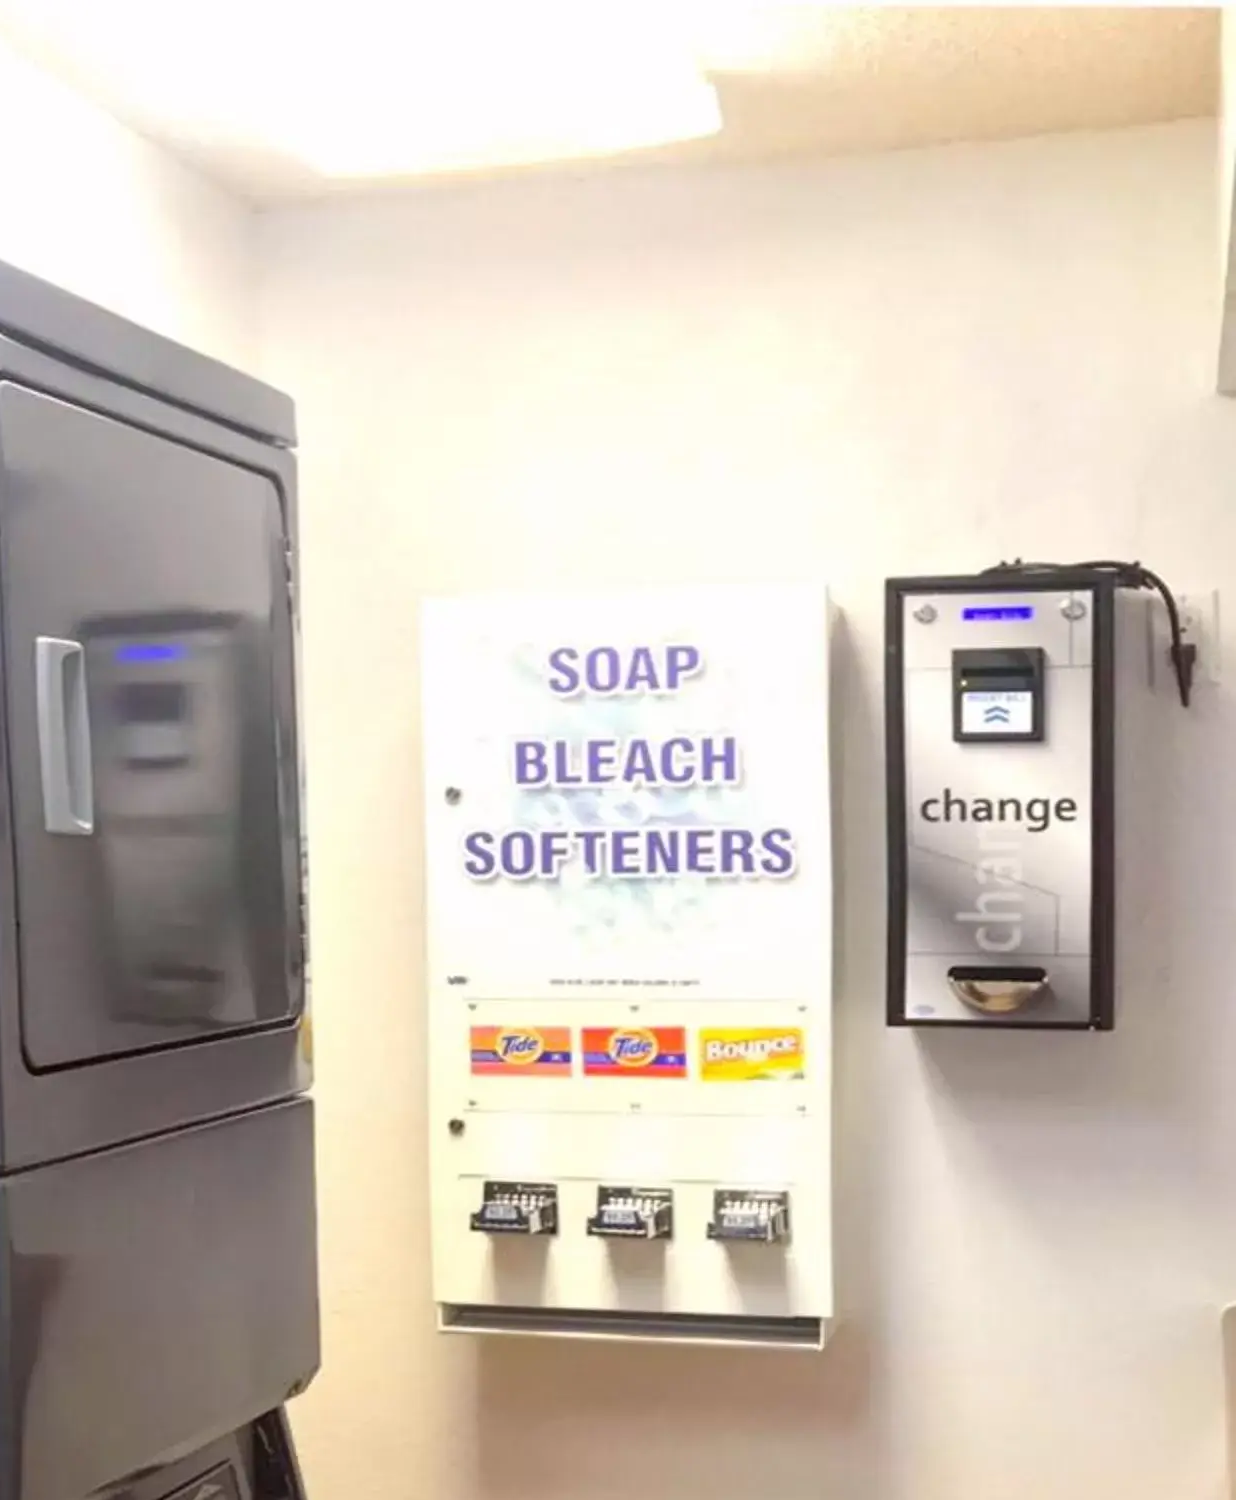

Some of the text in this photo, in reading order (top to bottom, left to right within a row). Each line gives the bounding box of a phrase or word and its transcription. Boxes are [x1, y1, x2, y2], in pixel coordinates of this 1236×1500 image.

[549, 645, 700, 693] SOAP
[515, 737, 736, 785] BLEACH
[920, 787, 1078, 833] change
[464, 828, 794, 876] SOFTENERS
[501, 1035, 539, 1056] Tide
[614, 1037, 653, 1058] Tide
[706, 1034, 798, 1062] Bounce
